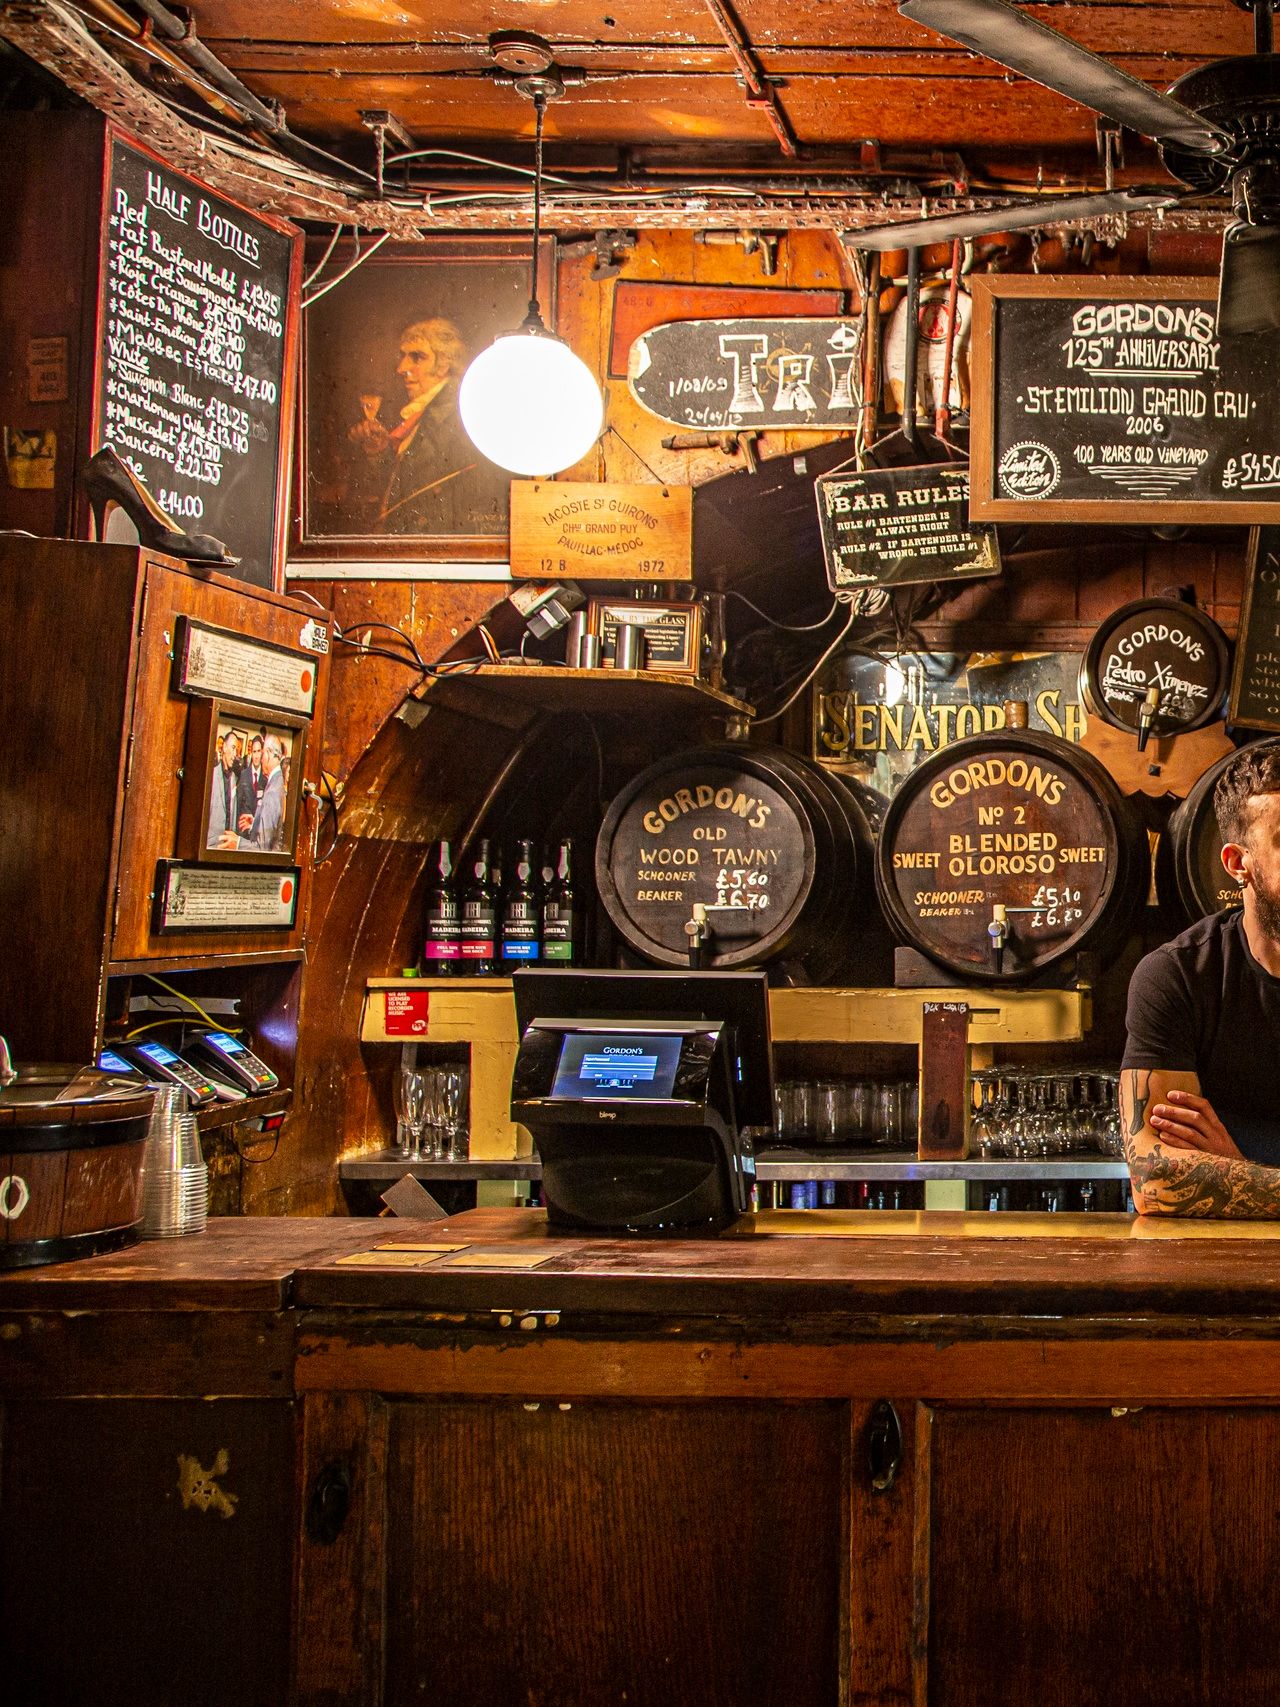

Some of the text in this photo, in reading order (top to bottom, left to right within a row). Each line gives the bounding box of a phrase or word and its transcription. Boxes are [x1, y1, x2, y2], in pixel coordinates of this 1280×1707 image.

[116, 188, 147, 227] Red
[146, 171, 259, 261] HALF BOTTLES
[119, 217, 203, 276] Fat Bastard
[118, 241, 175, 283] Cabernet
[116, 318, 277, 405] Malbec £17.00
[1143, 387, 1250, 418] GRAND CRU
[115, 404, 178, 445] Muscadet
[1126, 416, 1165, 435] 2006
[1134, 445, 1154, 464] OLD
[157, 488, 204, 519] £14.00
[835, 485, 970, 514] BAR RULES
[608, 499, 660, 530] GUIRONS
[837, 513, 937, 531] RULE BARTENDER
[585, 523, 638, 535] GRAND PUY
[875, 521, 949, 537] ALWAYS RIGHT
[901, 534, 959, 547] BARTENDER
[920, 543, 966, 556] SEE RULE
[638, 560, 665, 573] 1972
[1118, 624, 1206, 663] GORDON'S
[1105, 654, 1147, 683] Pedro
[1147, 660, 1208, 698] Ximenez
[930, 758, 1067, 808] GORDON'S
[642, 784, 772, 834] GORDON'S
[693, 827, 727, 841] OLD
[950, 832, 1058, 853] BLENDED
[639, 848, 782, 865] WOOD TAWNY
[892, 847, 1106, 877] SWEET OLOROSO SWEET
[637, 868, 768, 889] SCHOONER £5.60
[637, 890, 683, 901] BEAKER
[914, 885, 1081, 908] SCHOONER £5.10
[919, 907, 962, 917] BEAKER
[602, 1046, 643, 1056] GORDON'S
